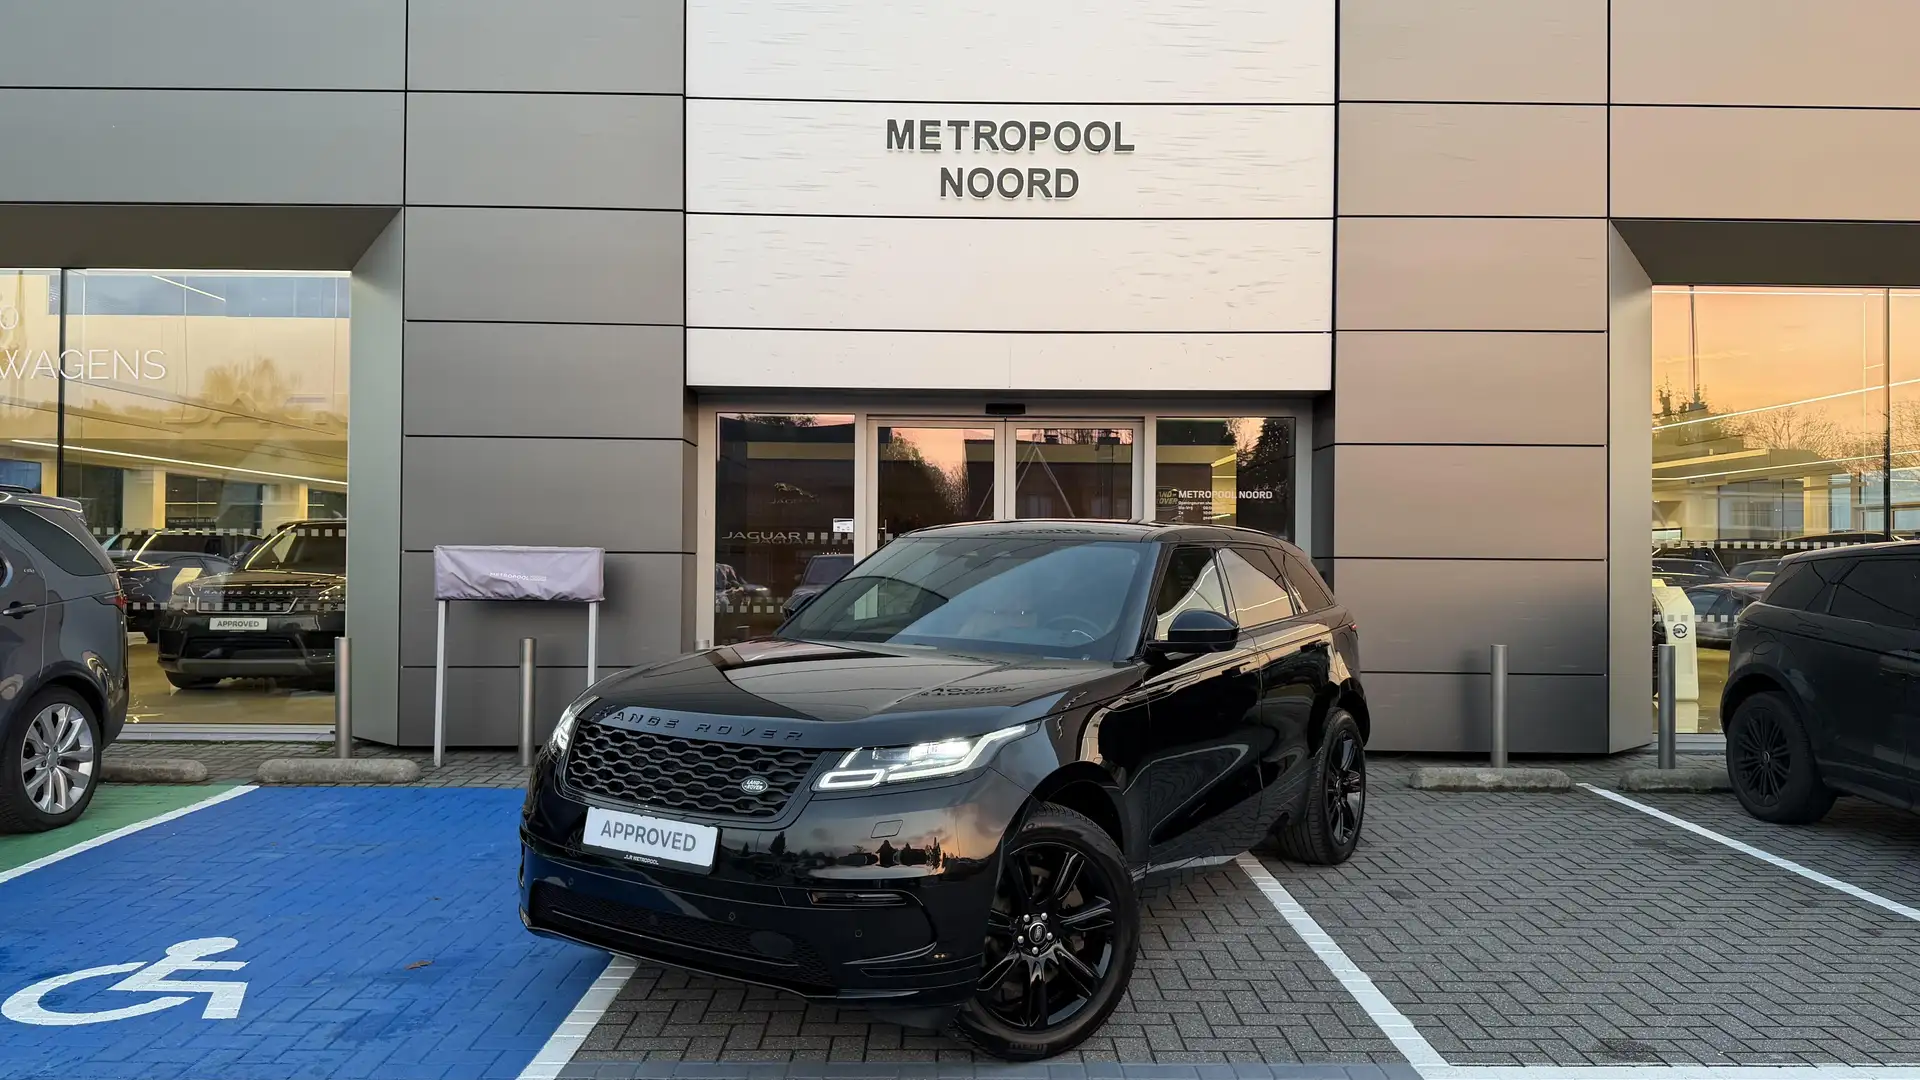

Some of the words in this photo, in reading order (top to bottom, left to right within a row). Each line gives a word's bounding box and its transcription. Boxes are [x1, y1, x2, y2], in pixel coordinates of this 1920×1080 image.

[886, 119, 1135, 152] METROPOOL
[940, 167, 1079, 199] NOORD
[1178, 490, 1237, 499] METROPOOL
[1238, 490, 1273, 499] NOORD
[721, 531, 801, 540] JAGUAR
[216, 620, 260, 628] APPROVED
[694, 723, 803, 741] ROVER
[600, 819, 697, 853] APPROVED
[633, 856, 659, 866] METROPOOL
